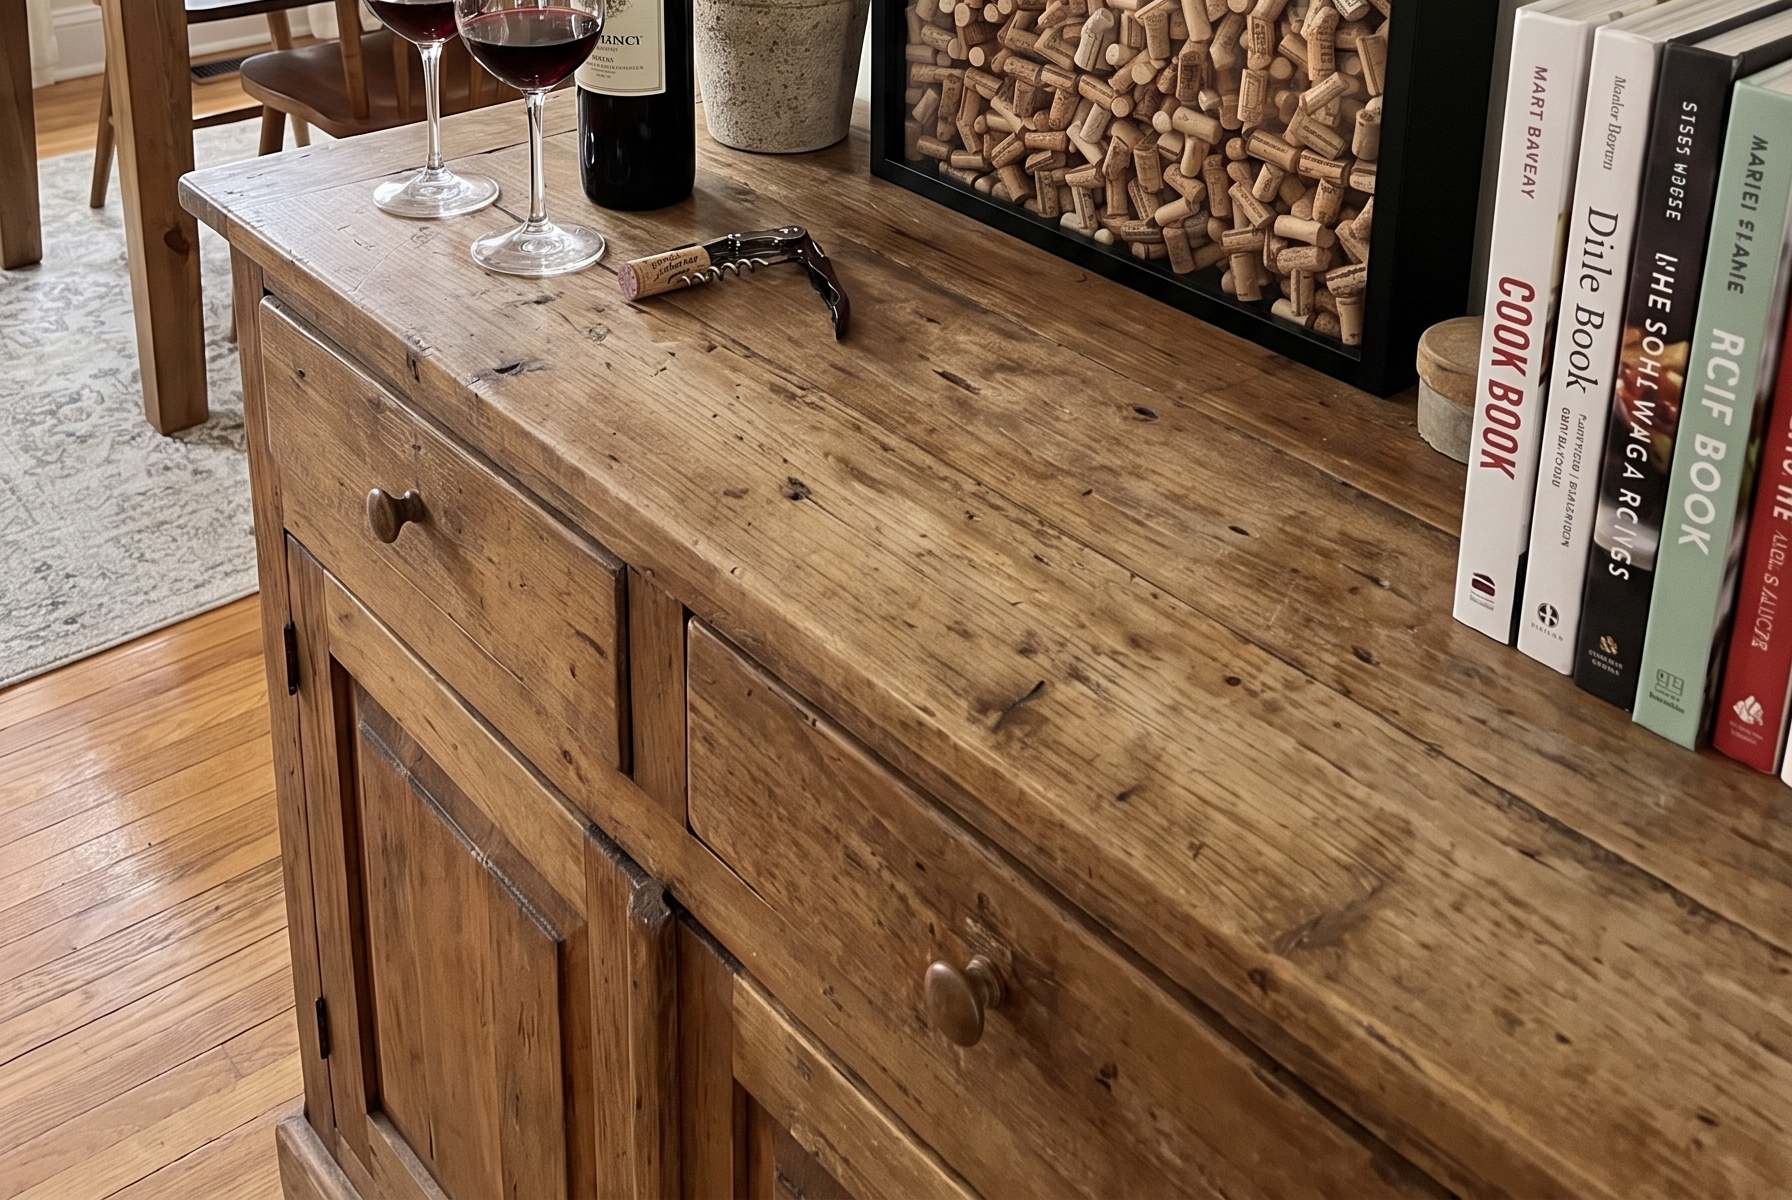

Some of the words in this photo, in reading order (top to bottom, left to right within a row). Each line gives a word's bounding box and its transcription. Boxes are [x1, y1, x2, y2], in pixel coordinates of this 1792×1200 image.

[1530, 65, 1548, 121] MART
[1490, 276, 1536, 378] COOK
[1566, 303, 1605, 394] Book
[1701, 328, 1746, 427] RCIF
[1479, 378, 1524, 481] BOOK
[1677, 433, 1727, 556] BOOK
